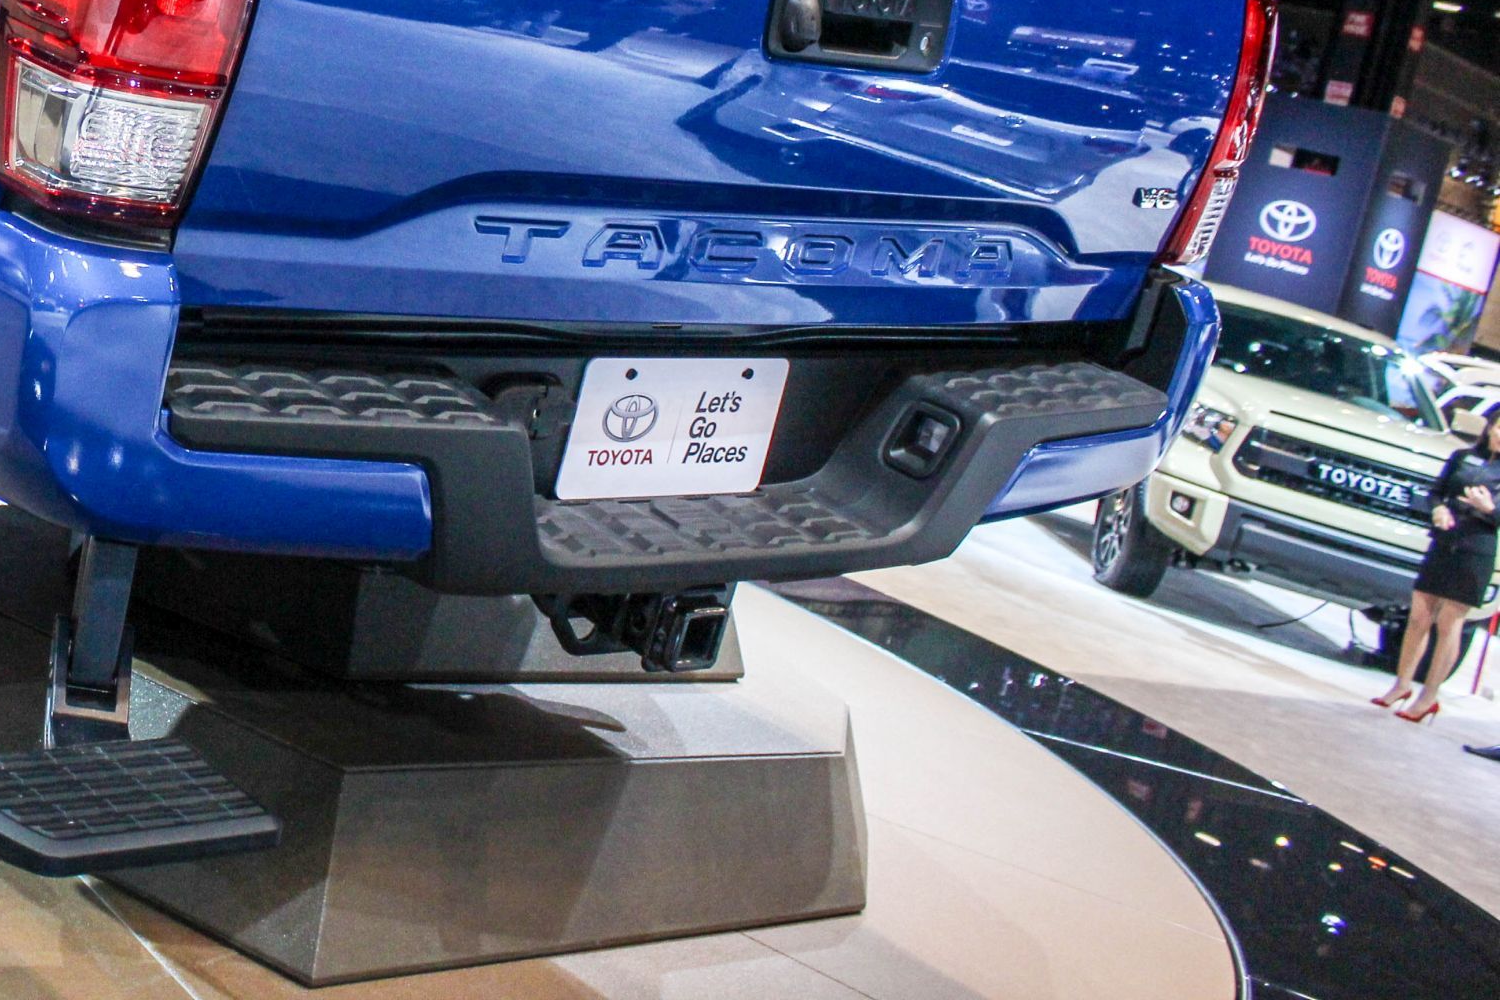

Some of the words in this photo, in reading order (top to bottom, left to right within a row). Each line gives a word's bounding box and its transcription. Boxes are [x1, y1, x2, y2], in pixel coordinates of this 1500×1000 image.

[474, 214, 1013, 279] TACOMA
[1248, 235, 1313, 265] TOYOTA
[695, 391, 742, 413] Let's
[689, 416, 717, 438] Go
[588, 449, 653, 466] TOYOTA
[682, 442, 748, 464] Places
[1318, 464, 1408, 503] TOYOTA
